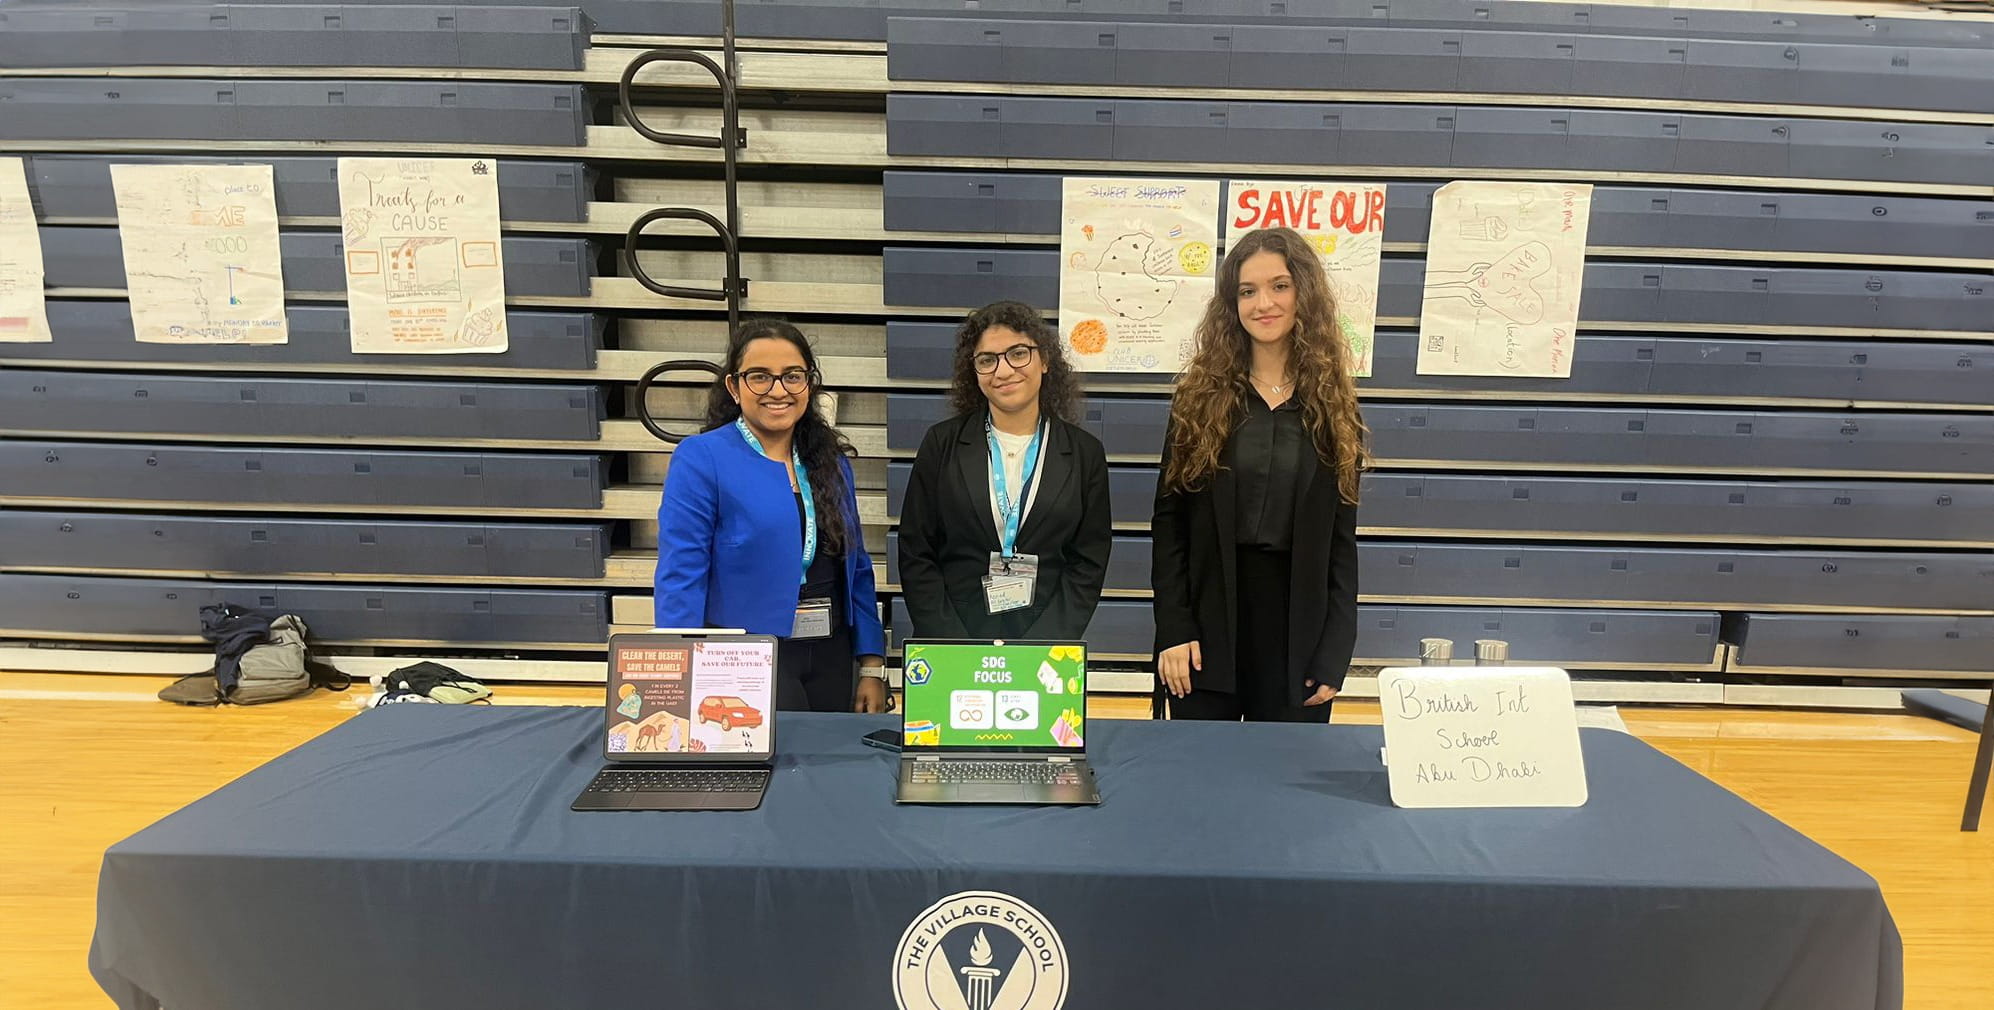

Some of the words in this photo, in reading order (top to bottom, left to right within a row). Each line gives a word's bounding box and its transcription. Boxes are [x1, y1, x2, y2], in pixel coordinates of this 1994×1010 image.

[353, 171, 417, 213] Treats
[425, 190, 446, 213] for
[454, 194, 464, 204] a
[392, 213, 449, 231] CAUSE
[1234, 189, 1323, 230] SAVE
[1330, 190, 1384, 234] OUR
[1502, 250, 1539, 281] BAKE
[1496, 286, 1535, 314] SALE
[1498, 322, 1521, 370] (Location)
[803, 519, 815, 561] INNOVATE
[622, 651, 643, 660] CLEAN
[645, 651, 657, 660] THE
[658, 651, 684, 663] DESERT,
[627, 663, 642, 671] SAVE
[644, 663, 655, 671] THE
[656, 663, 680, 671] CAMELS
[982, 657, 1005, 668] SDG
[974, 671, 1012, 683] FOCUS
[1391, 678, 1479, 720] British
[1495, 685, 1530, 716] Int
[1416, 763, 1457, 784] Abu
[1462, 756, 1541, 782] Dhabi
[907, 935, 929, 969] THE
[925, 904, 1001, 936] VILLAGE
[1003, 910, 1054, 972] SCHOOL
